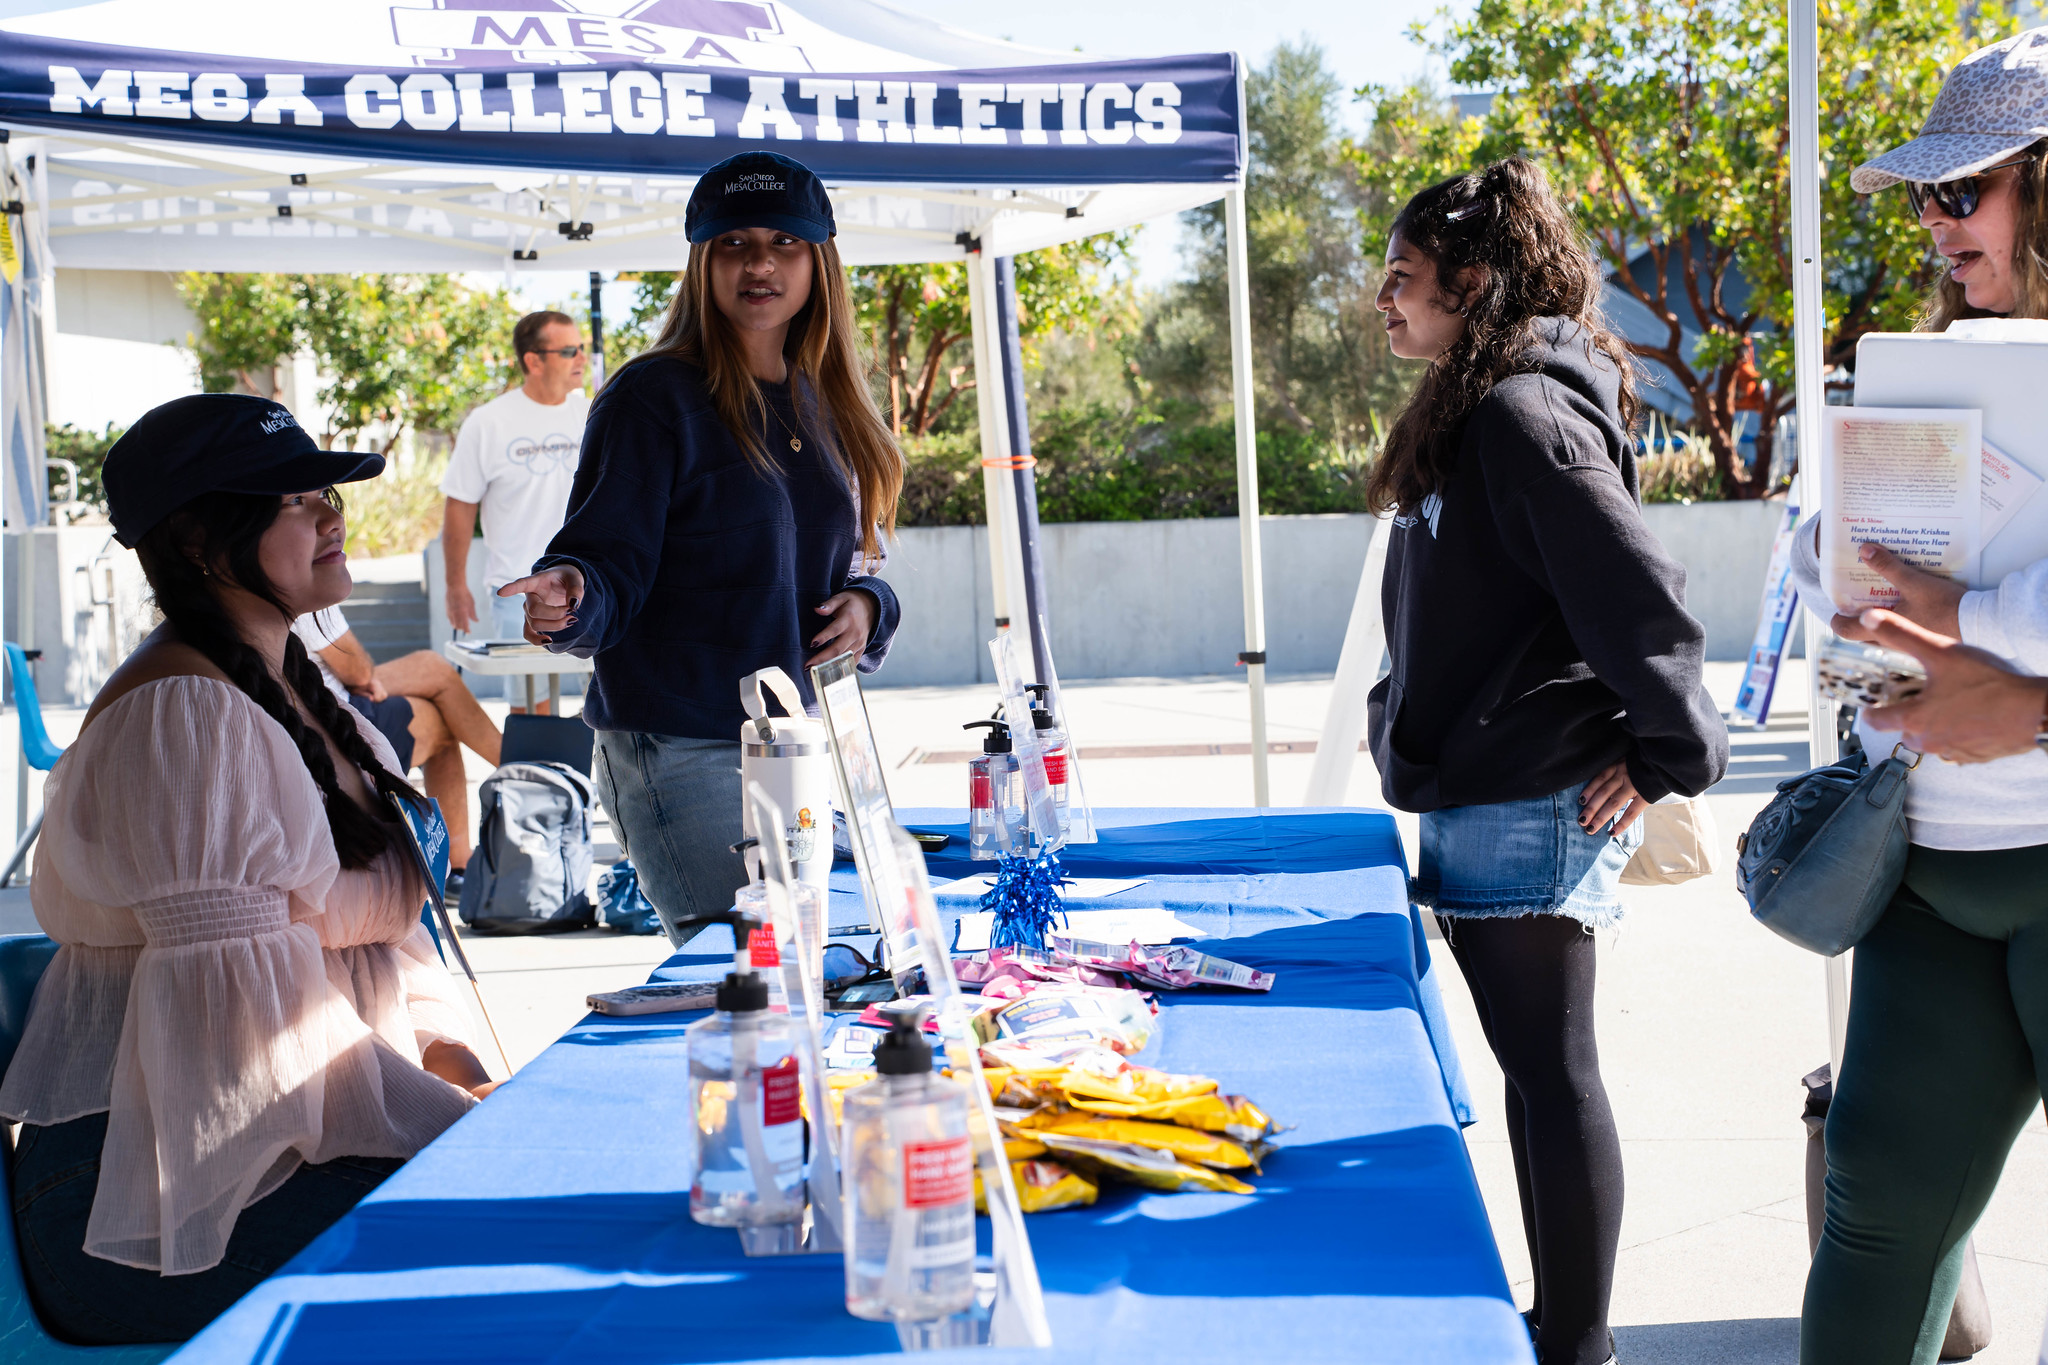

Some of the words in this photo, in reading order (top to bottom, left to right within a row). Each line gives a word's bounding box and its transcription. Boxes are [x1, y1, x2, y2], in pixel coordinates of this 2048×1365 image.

[470, 15, 743, 65] MESA
[344, 70, 716, 138] COLLEGE
[737, 76, 1183, 146] ATHLETICS
[738, 174, 753, 182] SAN
[753, 173, 775, 181] DIEGO
[1870, 526, 1899, 534] Krishna
[1920, 528, 1950, 536] Krishna
[1881, 537, 1910, 545] Krishna
[1911, 538, 1929, 546] Hare
[1931, 539, 1950, 547] Hare
[1901, 548, 1919, 556] Hare
[1920, 548, 1942, 556] Rama
[1904, 558, 1922, 566] Hare
[1923, 559, 1942, 567] Hare
[1869, 586, 1900, 597] krishn
